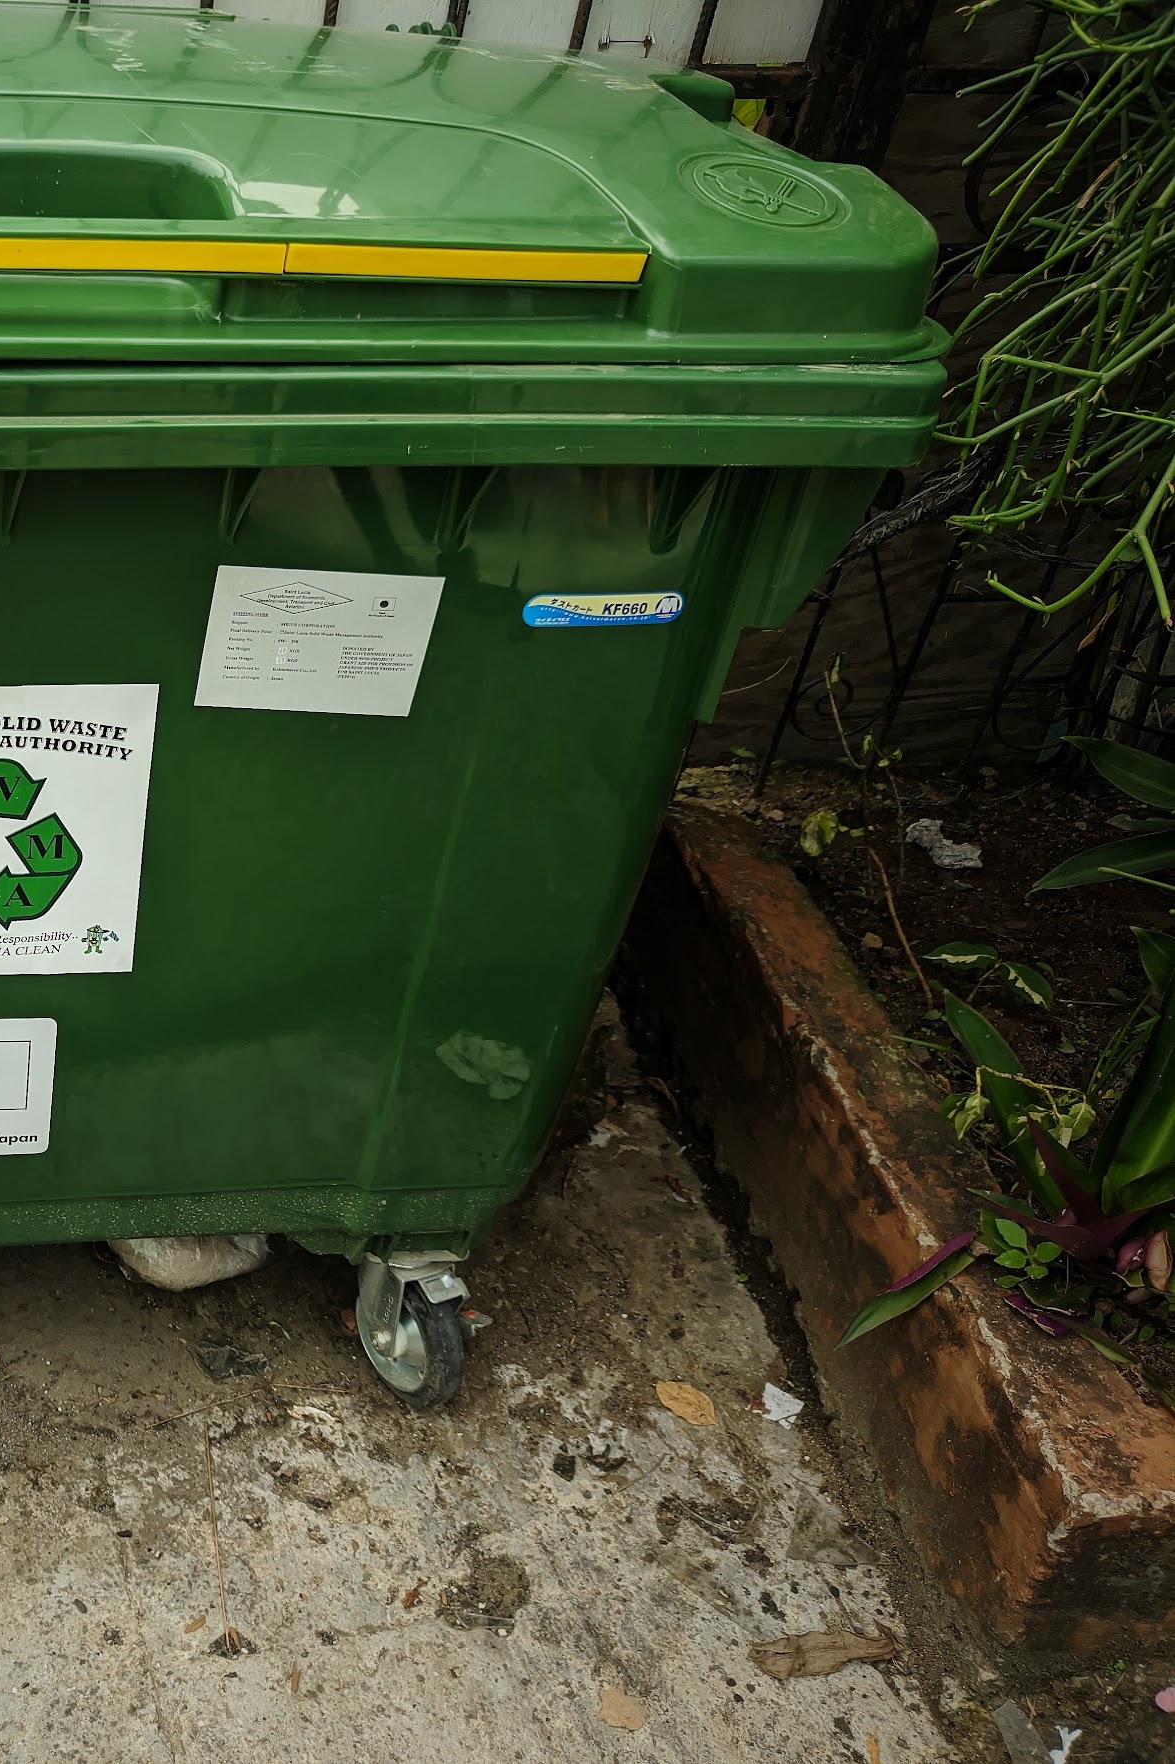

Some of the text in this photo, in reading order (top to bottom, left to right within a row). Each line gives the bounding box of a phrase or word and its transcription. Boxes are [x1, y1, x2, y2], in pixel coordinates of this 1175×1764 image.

[551, 598, 593, 613] ダストカート
[602, 603, 648, 615] KF660
[49, 718, 128, 742] WASTE
[26, 834, 66, 860] M
[2, 882, 34, 908] A
[15, 943, 62, 956] CLEAN
